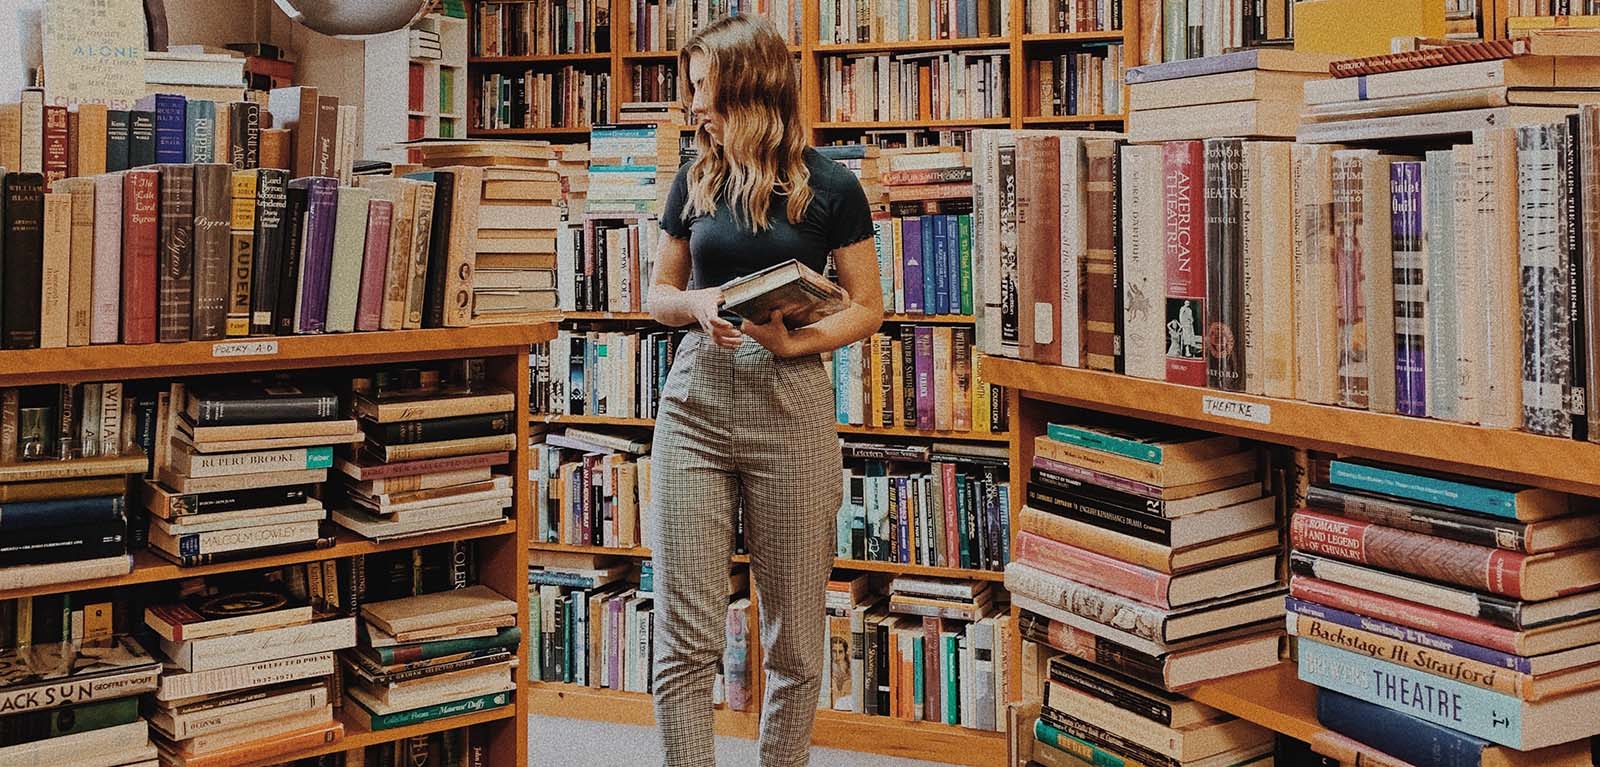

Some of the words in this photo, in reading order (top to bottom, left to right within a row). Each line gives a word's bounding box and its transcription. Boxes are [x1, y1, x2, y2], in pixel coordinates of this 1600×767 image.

[73, 46, 138, 58] ALONE
[9, 184, 42, 192] WILLIAM
[138, 178, 154, 188] The
[266, 176, 282, 185] Lord
[136, 190, 154, 200] Late
[1006, 175, 1015, 217] SCENE
[134, 202, 156, 212] Lord
[1166, 172, 1178, 254] THEATRE
[131, 214, 156, 225] Byron
[193, 215, 230, 231] Byron
[1178, 170, 1192, 272] AMERICAN
[167, 227, 189, 276] Byron
[236, 240, 251, 307] AUDEN
[215, 346, 248, 354] POETRY
[991, 388, 999, 411] GOLDEN
[1207, 398, 1253, 417] THEATRE
[202, 455, 246, 468] RUPERT
[250, 453, 296, 466] BROOKE
[308, 454, 330, 462] Faber
[1309, 520, 1349, 535] ROMANCE
[202, 532, 252, 548] MALCOLM
[254, 526, 297, 542] COWLEY
[1308, 530, 1326, 540] AND
[1327, 534, 1360, 548] LEGEND
[1309, 542, 1320, 552] OF
[1320, 544, 1361, 560] CHIVALRY
[1310, 621, 1384, 656] Backstage
[1392, 644, 1410, 664] At
[1413, 650, 1496, 686] Stratford
[251, 660, 302, 672] COLLECTED
[303, 654, 332, 664] POEMS
[45, 682, 93, 705] SUN
[94, 679, 129, 691] GEOFFREY
[1373, 670, 1462, 722] THEATRE
[466, 698, 485, 711] Duffy
